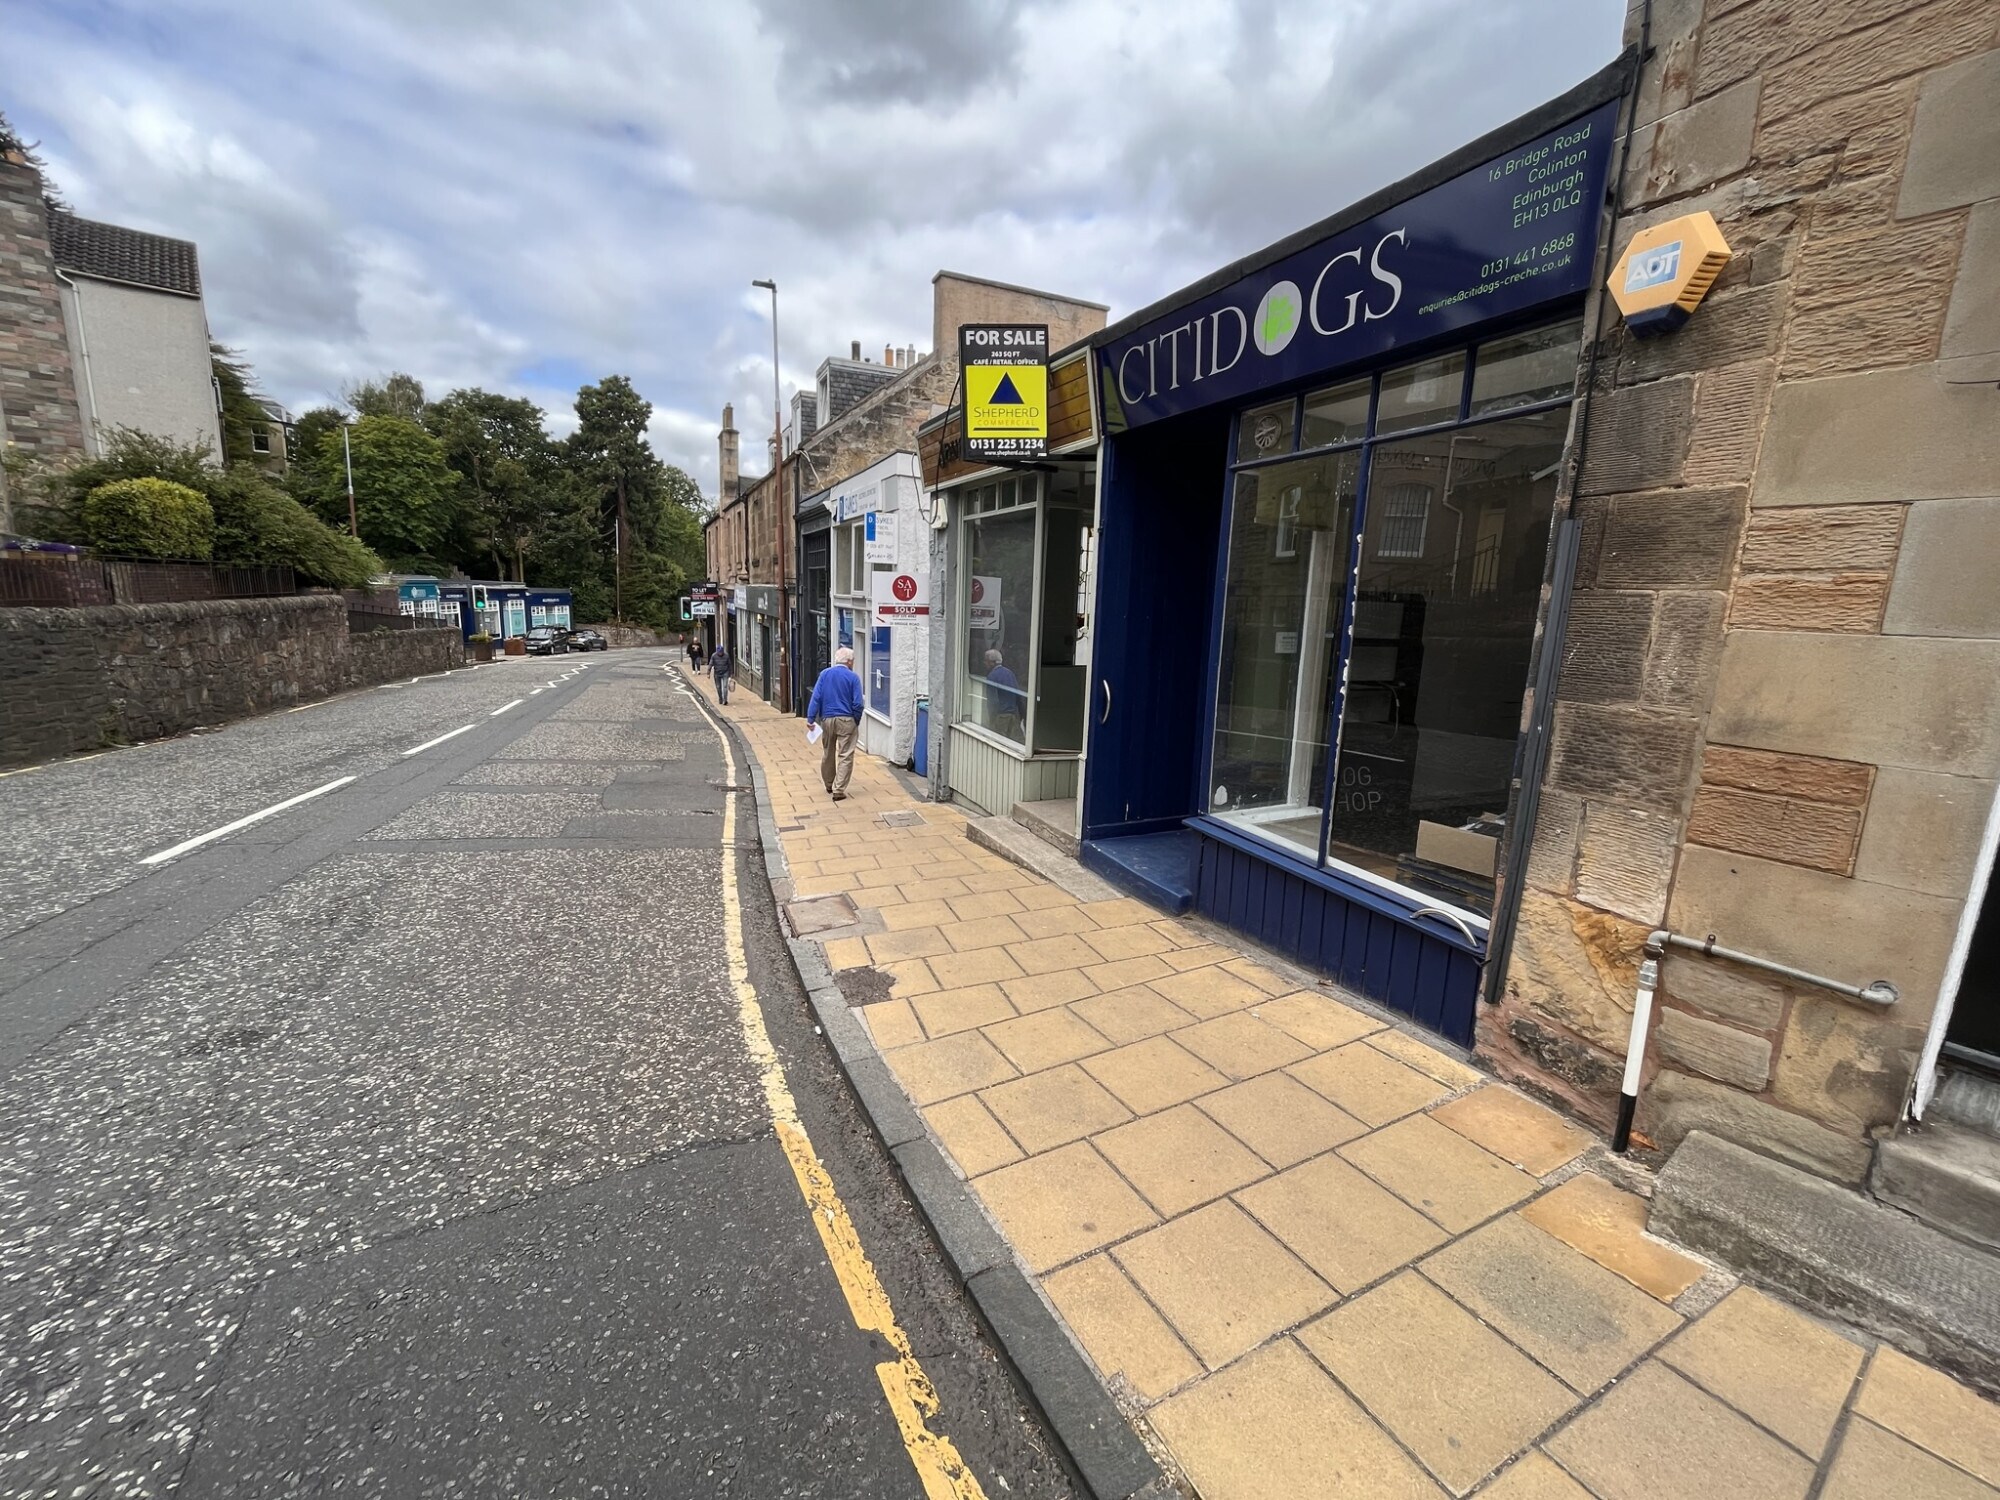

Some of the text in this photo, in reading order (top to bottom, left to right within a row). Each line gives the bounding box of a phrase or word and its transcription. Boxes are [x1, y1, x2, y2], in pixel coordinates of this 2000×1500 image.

[1488, 123, 1592, 182] 16 Bridge Road
[1528, 149, 1587, 183] Colinton
[1512, 170, 1584, 210] Edinburgh
[1513, 202, 1549, 229] EH13
[1481, 233, 1575, 278] 0131 441 6868
[1628, 249, 1681, 285] ADT
[1418, 254, 1572, 315] enquiries@citidogs-creche.co.uk
[965, 330, 1046, 346] FOR SALE
[970, 439, 1044, 449] 0131 225 1234
[1343, 766, 1372, 787] OG
[1337, 791, 1382, 812] HOP
